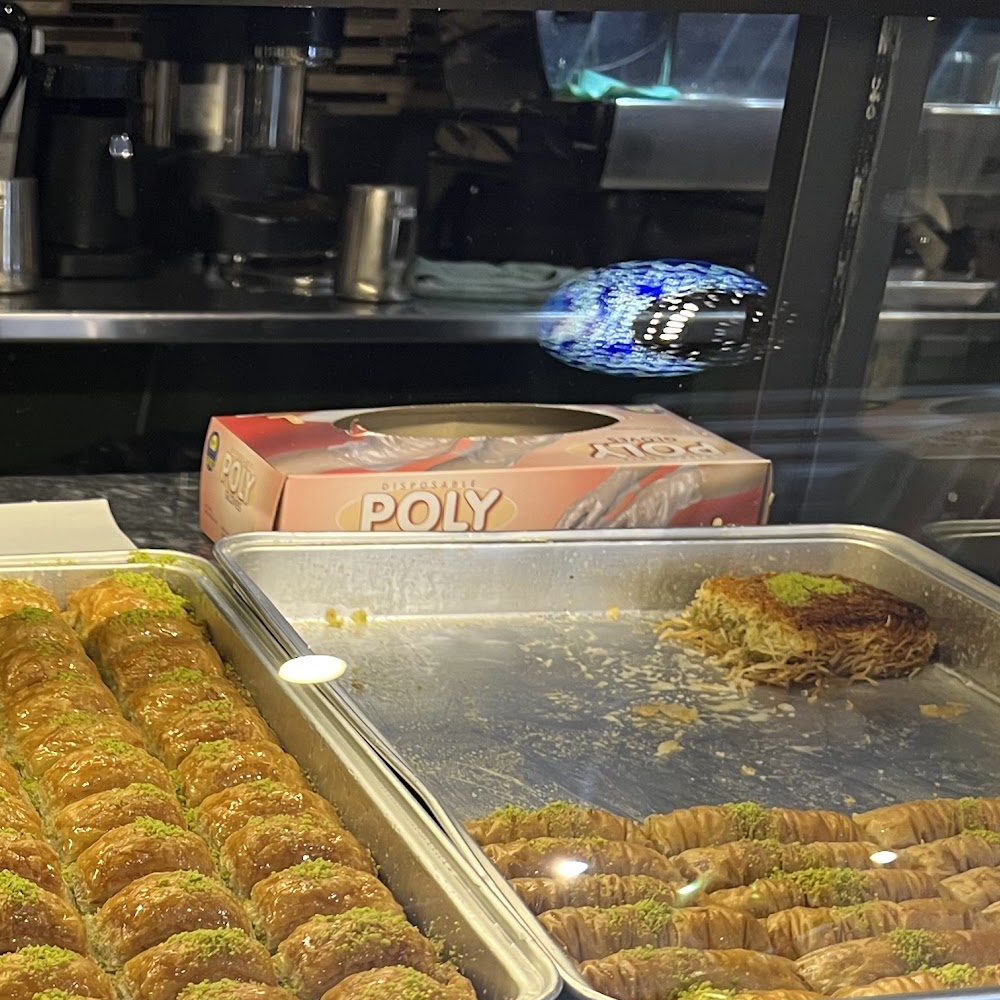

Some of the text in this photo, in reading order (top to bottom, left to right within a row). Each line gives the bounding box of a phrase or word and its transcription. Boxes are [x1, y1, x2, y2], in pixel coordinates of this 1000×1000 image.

[589, 441, 726, 461] POLY
[219, 452, 256, 507] POLY
[382, 479, 476, 490] DISPOSABLE
[359, 488, 502, 532] POLY
